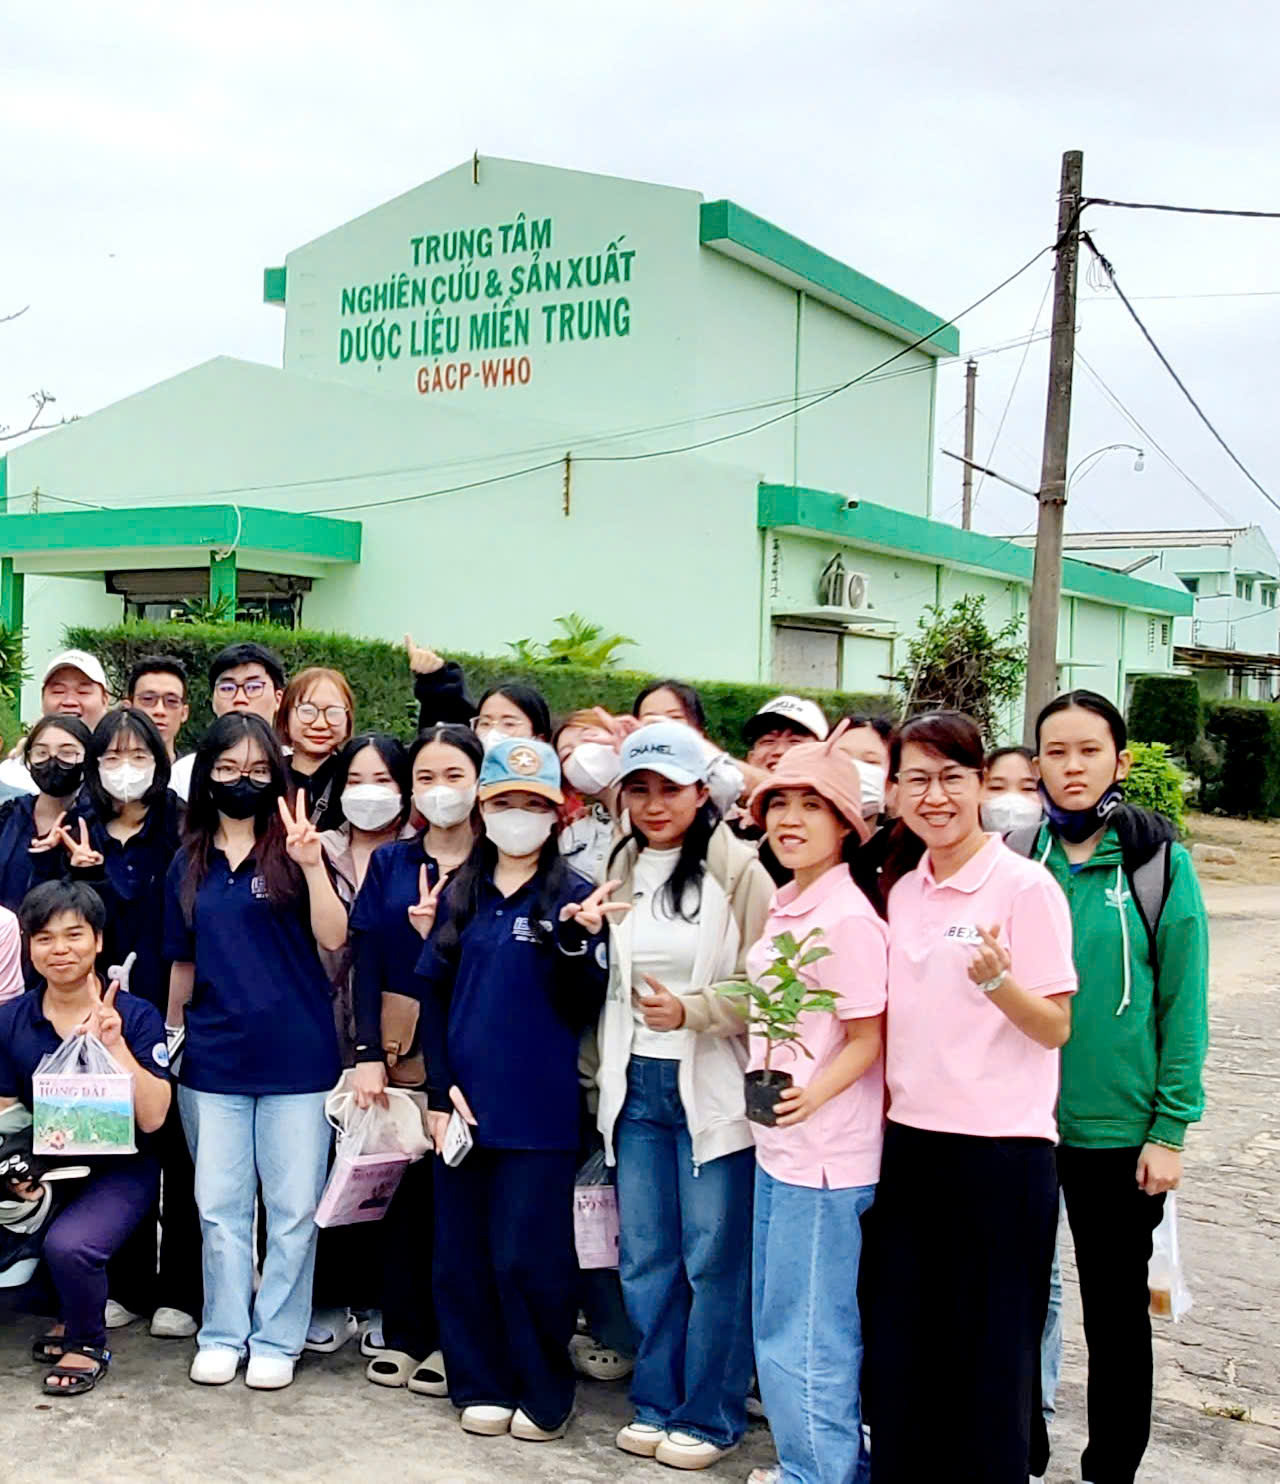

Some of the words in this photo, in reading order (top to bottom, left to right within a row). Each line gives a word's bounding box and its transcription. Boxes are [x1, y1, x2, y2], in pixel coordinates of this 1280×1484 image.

[410, 227, 493, 266] TRUNG
[498, 212, 552, 254] TÂM
[484, 268, 503, 299] &
[509, 251, 561, 296] SẢN
[567, 234, 636, 288] XUẤT
[339, 317, 402, 372] DƯỢC
[542, 296, 631, 344] TRUNG
[417, 356, 532, 394] GACP-WHO
